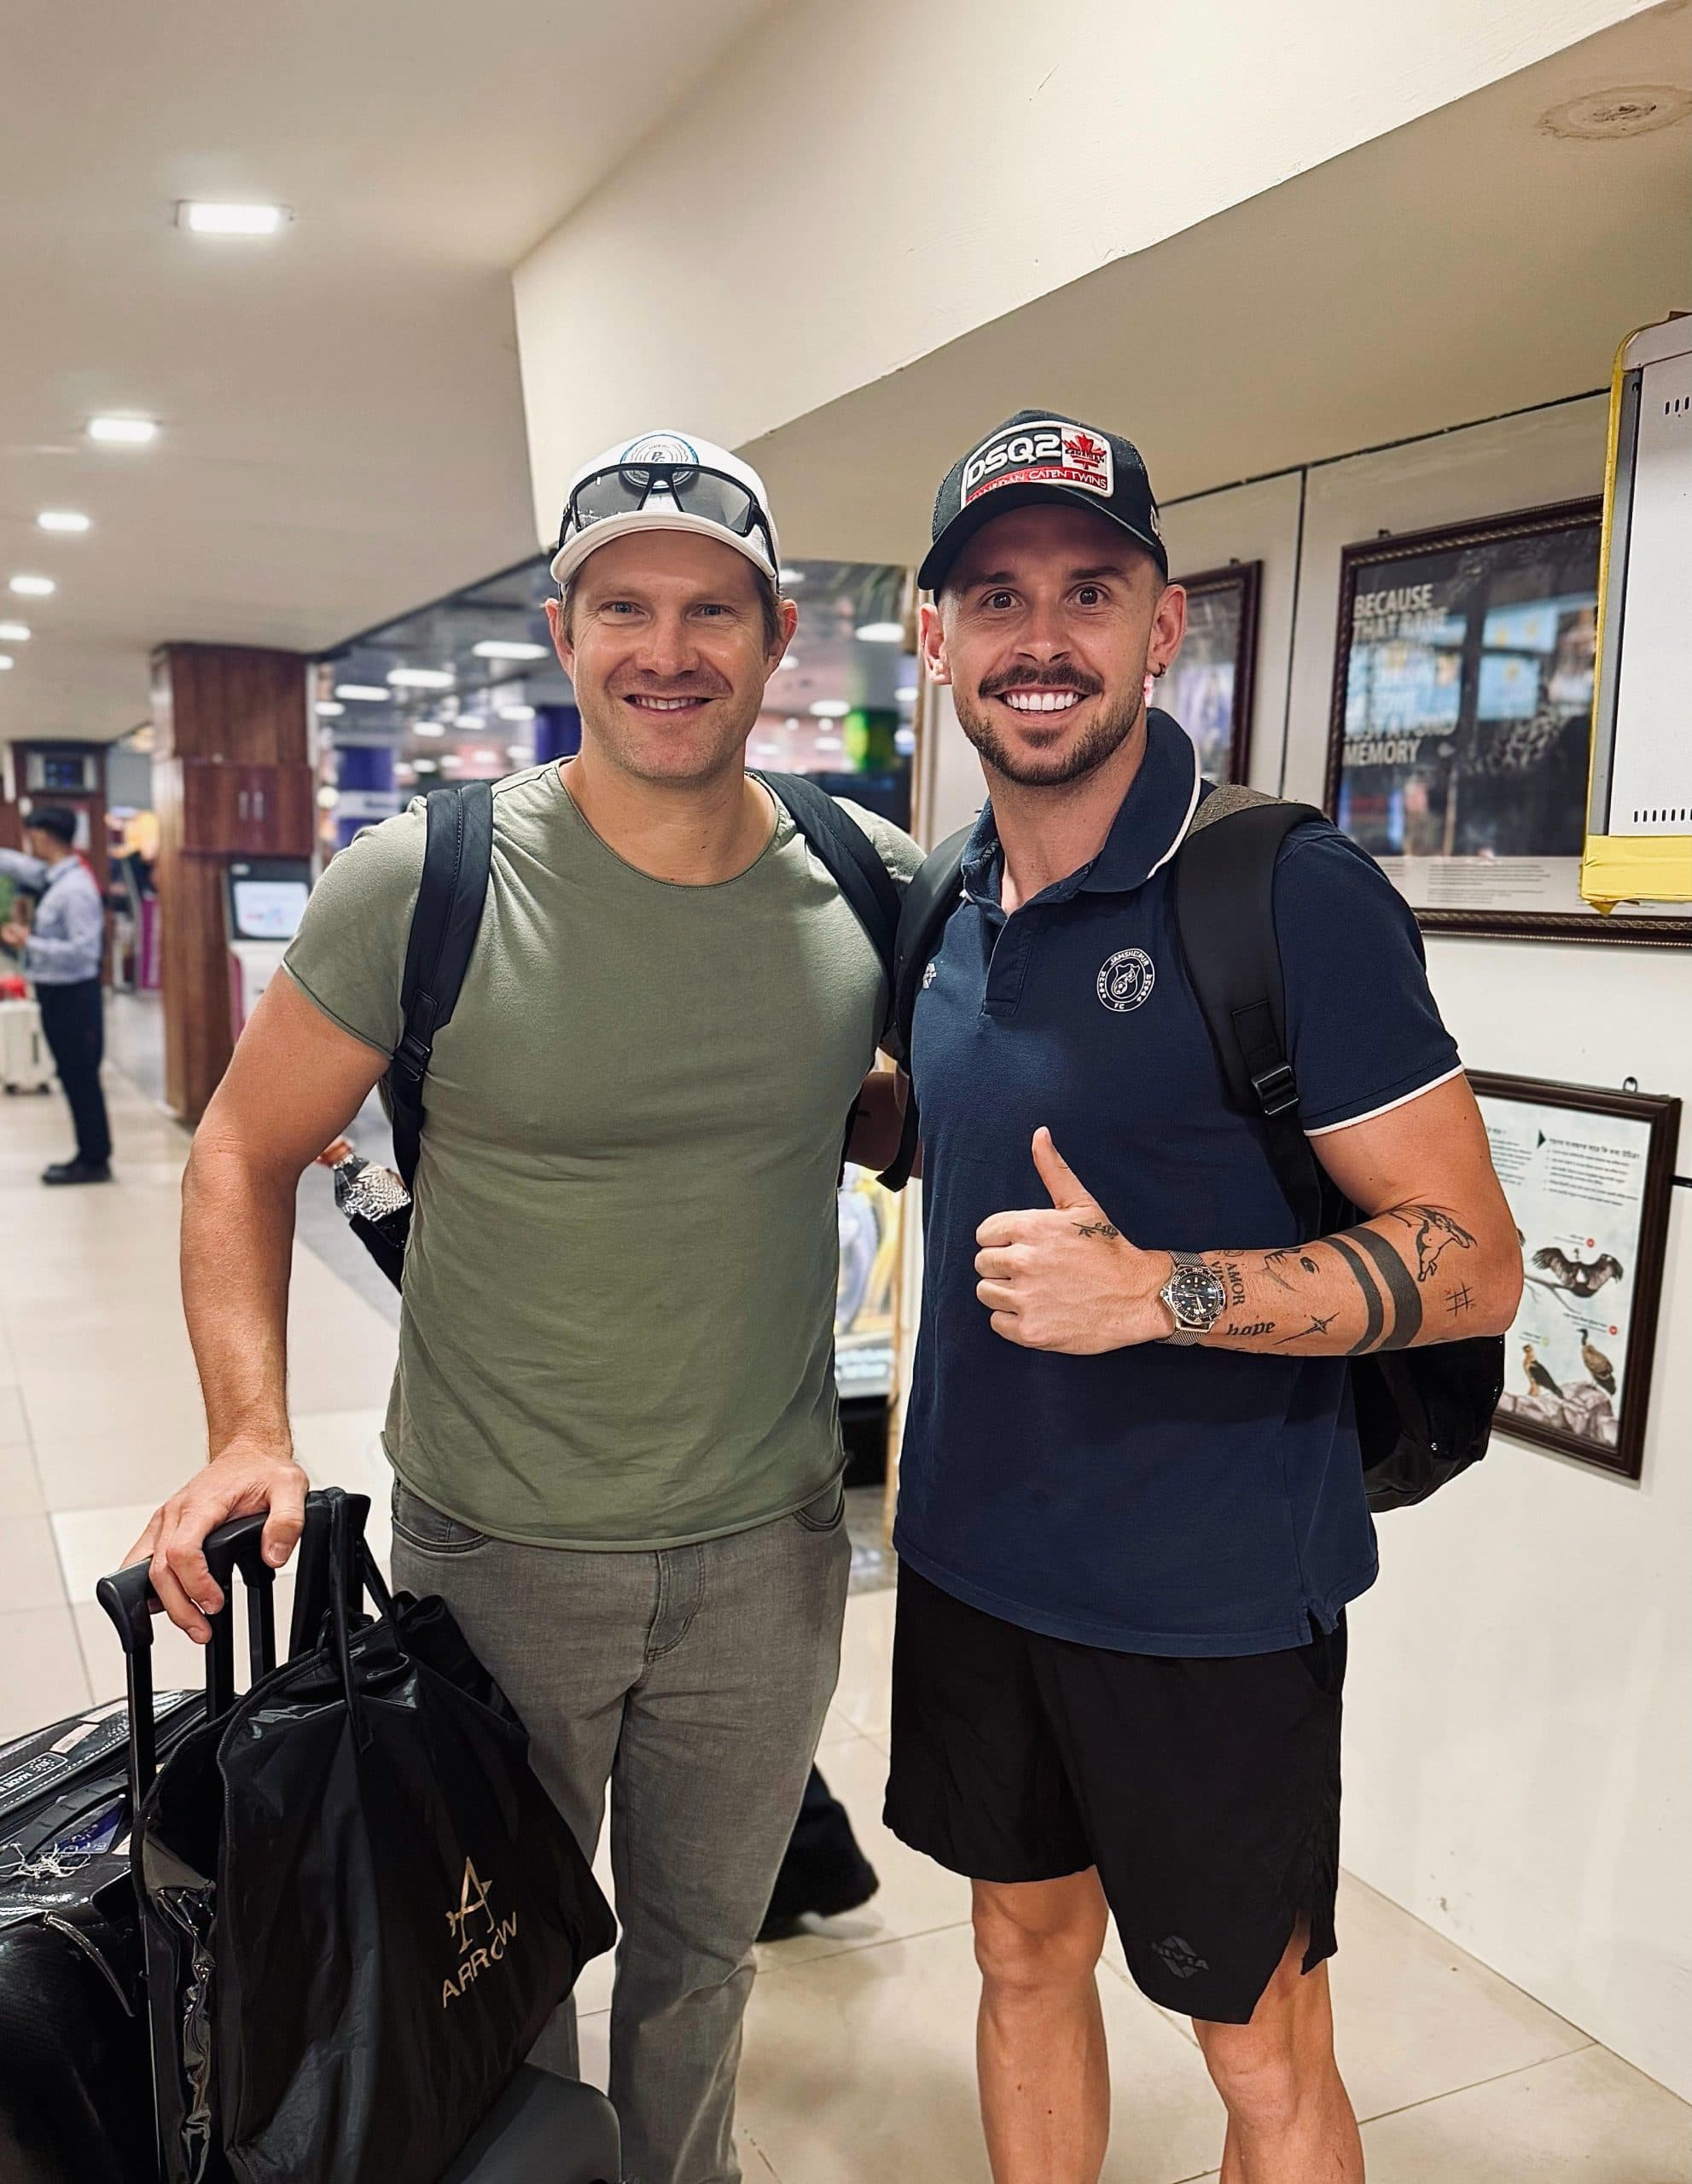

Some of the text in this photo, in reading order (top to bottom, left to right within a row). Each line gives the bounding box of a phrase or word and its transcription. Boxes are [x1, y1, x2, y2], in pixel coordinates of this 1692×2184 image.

[967, 433, 1061, 489] DSQ2
[1028, 469, 1067, 479] CATEN
[1072, 471, 1107, 489] TWINS
[1353, 584, 1433, 619] BECAUSE
[1343, 739, 1422, 765] MEMORY
[1225, 1262, 1246, 1307] AMOR
[1226, 1321, 1276, 1336] hope
[443, 1911, 517, 2008] ARROW
